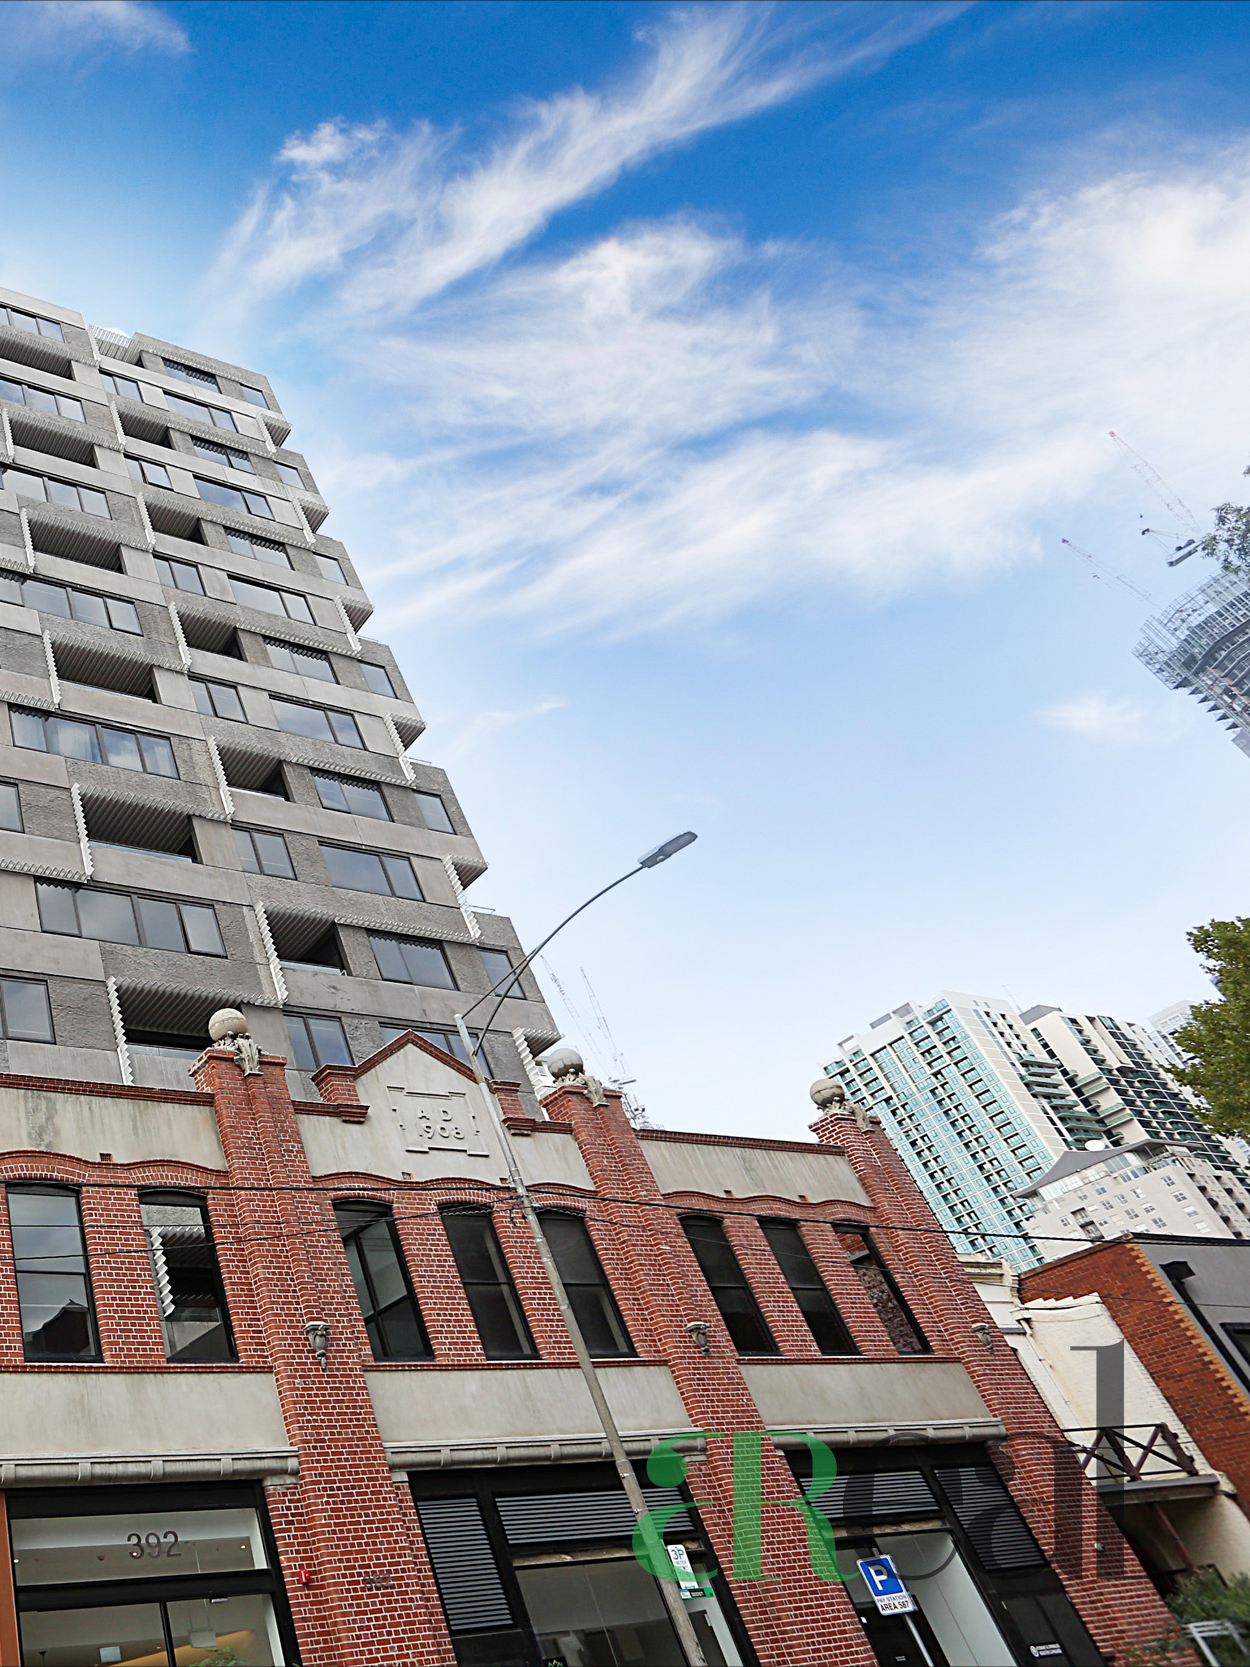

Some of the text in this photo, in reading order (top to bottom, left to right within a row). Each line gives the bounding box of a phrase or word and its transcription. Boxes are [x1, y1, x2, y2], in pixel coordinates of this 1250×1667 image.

[415, 1123, 465, 1139] 1908
[127, 1530, 182, 1559] 392
[671, 1549, 685, 1560] 3P
[363, 1572, 393, 1589] 392
[868, 1564, 888, 1590] P
[886, 1594, 907, 1602] STATION
[880, 1602, 898, 1611] AREA
